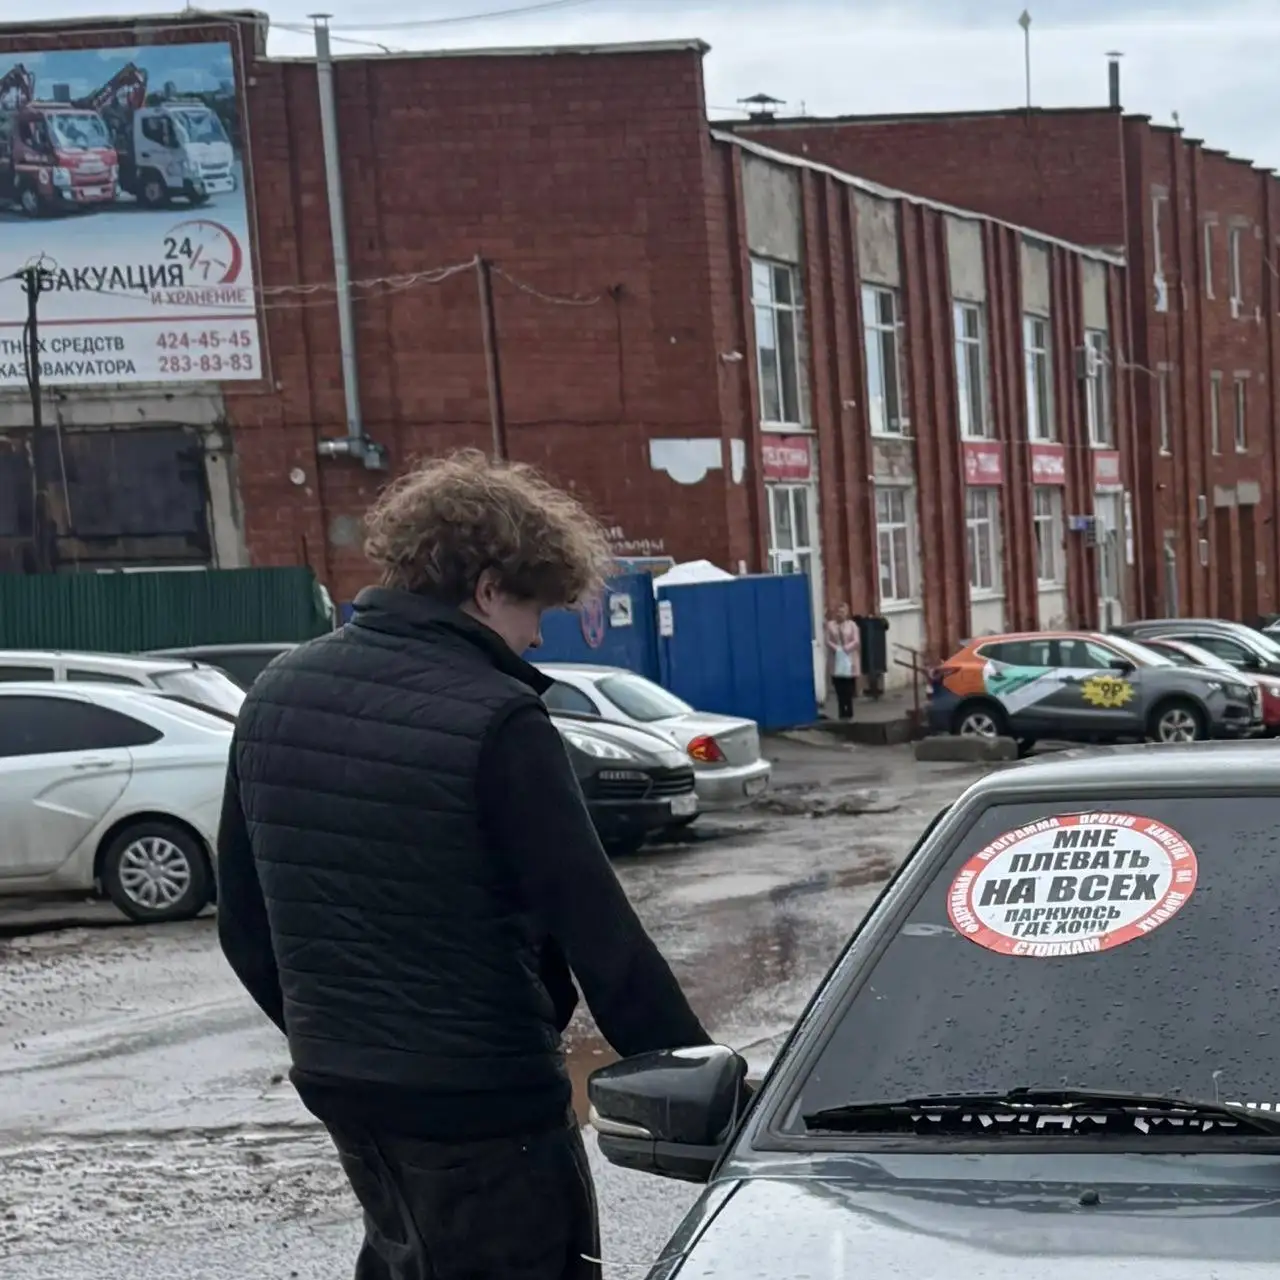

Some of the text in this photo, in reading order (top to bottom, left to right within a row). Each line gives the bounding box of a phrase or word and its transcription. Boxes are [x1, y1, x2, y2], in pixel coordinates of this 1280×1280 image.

[163, 237, 211, 280] 24/7
[151, 288, 247, 305] И ХРАНЕНИЕ
[51, 336, 125, 356] СРЕДСТВ
[155, 330, 252, 349] 424-45-45
[36, 359, 136, 377] ВАКУАТОРА
[158, 354, 253, 373] 283-83-83
[977, 817, 1061, 861] ПРОГРАММА
[1079, 813, 1137, 827] ПРОТИВ
[1053, 829, 1118, 849] МНЕ
[1008, 849, 1150, 873] ПЛЕВАТЬ
[979, 873, 1161, 906] НА ВСЕХ
[1003, 905, 1121, 923] ПАРКУЮСЬ
[1012, 919, 1110, 937] ГДЕ ХОЧУ
[1011, 938, 1101, 957] СТОПХАМ
